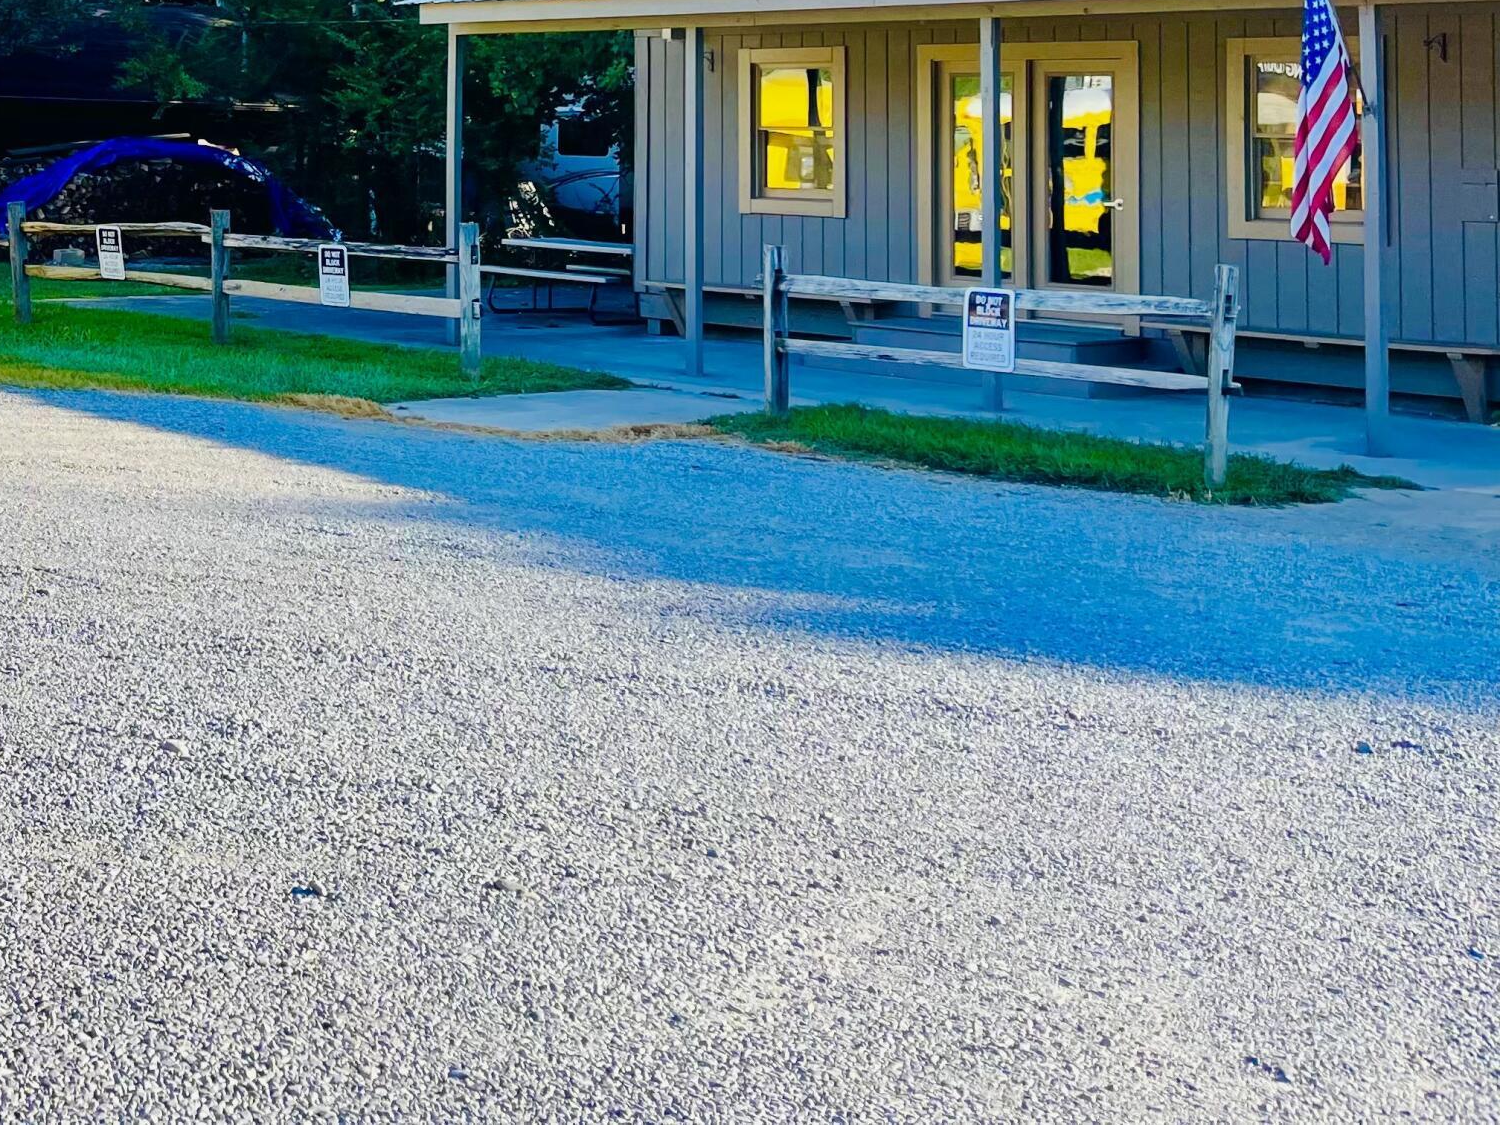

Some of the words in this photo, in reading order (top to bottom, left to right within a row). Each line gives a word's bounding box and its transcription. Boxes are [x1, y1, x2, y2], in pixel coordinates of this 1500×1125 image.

[975, 295, 986, 304] DO
[987, 295, 1003, 306] NOT
[976, 305, 1001, 317] BLOCK
[969, 315, 1008, 328] DRIVEWAY
